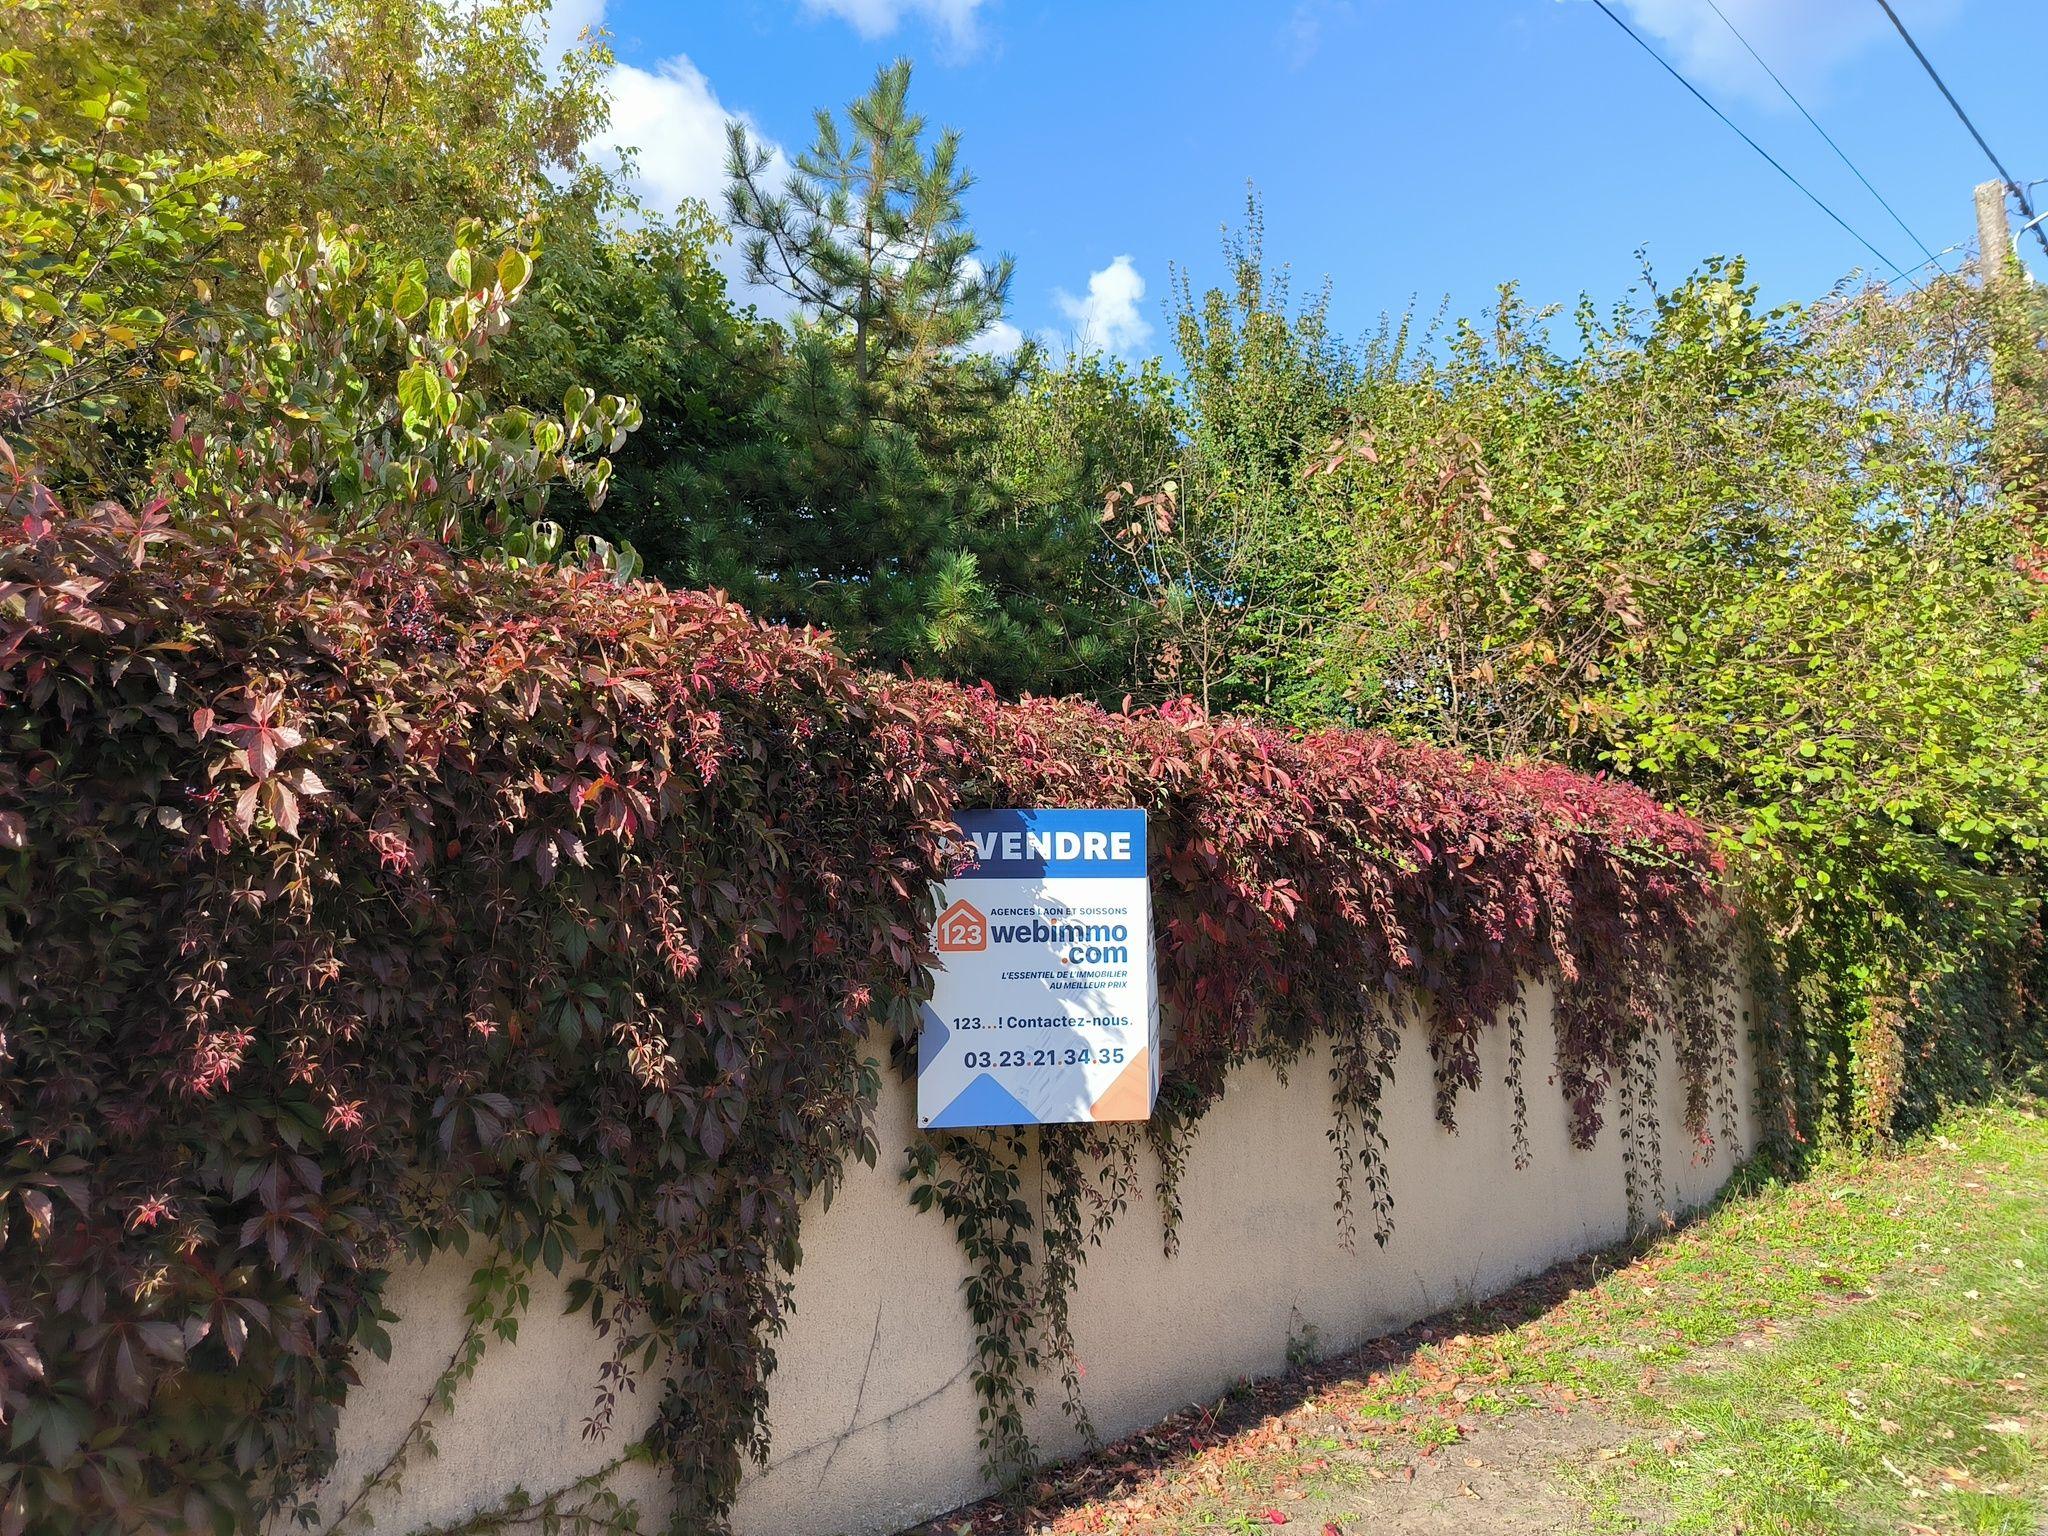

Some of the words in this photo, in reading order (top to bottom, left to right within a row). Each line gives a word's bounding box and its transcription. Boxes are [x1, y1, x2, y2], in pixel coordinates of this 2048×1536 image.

[971, 831, 1131, 861] VENDRE
[990, 908, 1035, 916] AGENCES
[1036, 907, 1063, 916] LAON
[1065, 907, 1077, 916] ET
[1079, 907, 1128, 915] SOISSONS
[941, 924, 982, 945] 123
[991, 918, 1128, 943] webimmo
[1061, 946, 1128, 964] .com
[1001, 971, 1055, 980] L'ESSENTIEL
[1056, 971, 1069, 979] DE
[1070, 970, 1128, 979] L'IMMOBILIER
[1049, 982, 1063, 990] AU
[1063, 981, 1107, 990] MEILLEUR
[1107, 981, 1128, 989] PRIX
[964, 1048, 1125, 1069] 03.23.21.34.35
